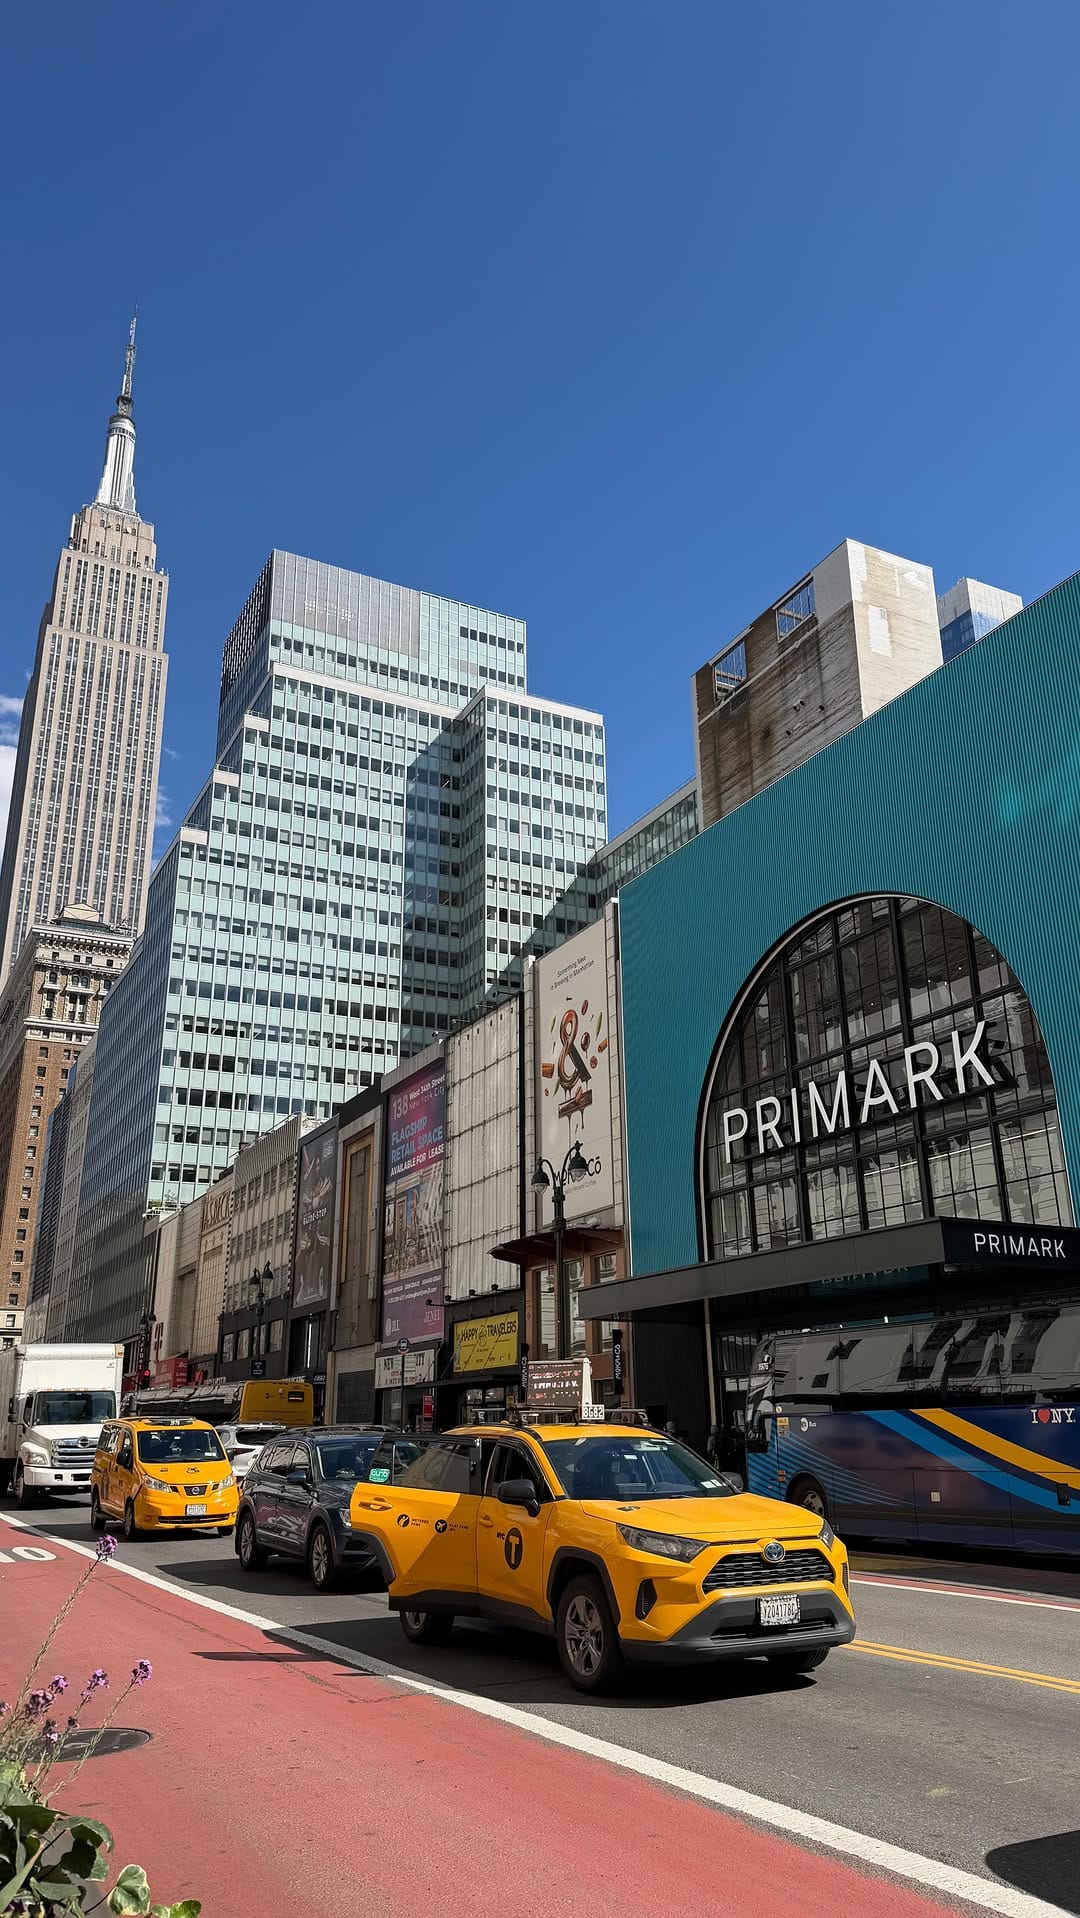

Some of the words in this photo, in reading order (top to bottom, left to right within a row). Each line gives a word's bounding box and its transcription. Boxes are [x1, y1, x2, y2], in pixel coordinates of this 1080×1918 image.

[722, 1020, 996, 1165] PRIMARK
[392, 1093, 409, 1121] 138
[391, 1115, 428, 1146] FLAGSHIP
[391, 1141, 416, 1164] RETAIL
[417, 1125, 444, 1151] SPACE
[390, 1156, 416, 1177] AVAILABLE
[416, 1151, 427, 1164] FOR
[428, 1142, 445, 1159] LEASE
[973, 1232, 1067, 1259] PRIMARK
[461, 1327, 479, 1342] HAPPY
[487, 1320, 517, 1337] TRAVELERS
[1031, 1409, 1039, 1424] I
[496, 1530, 506, 1541] NYC
